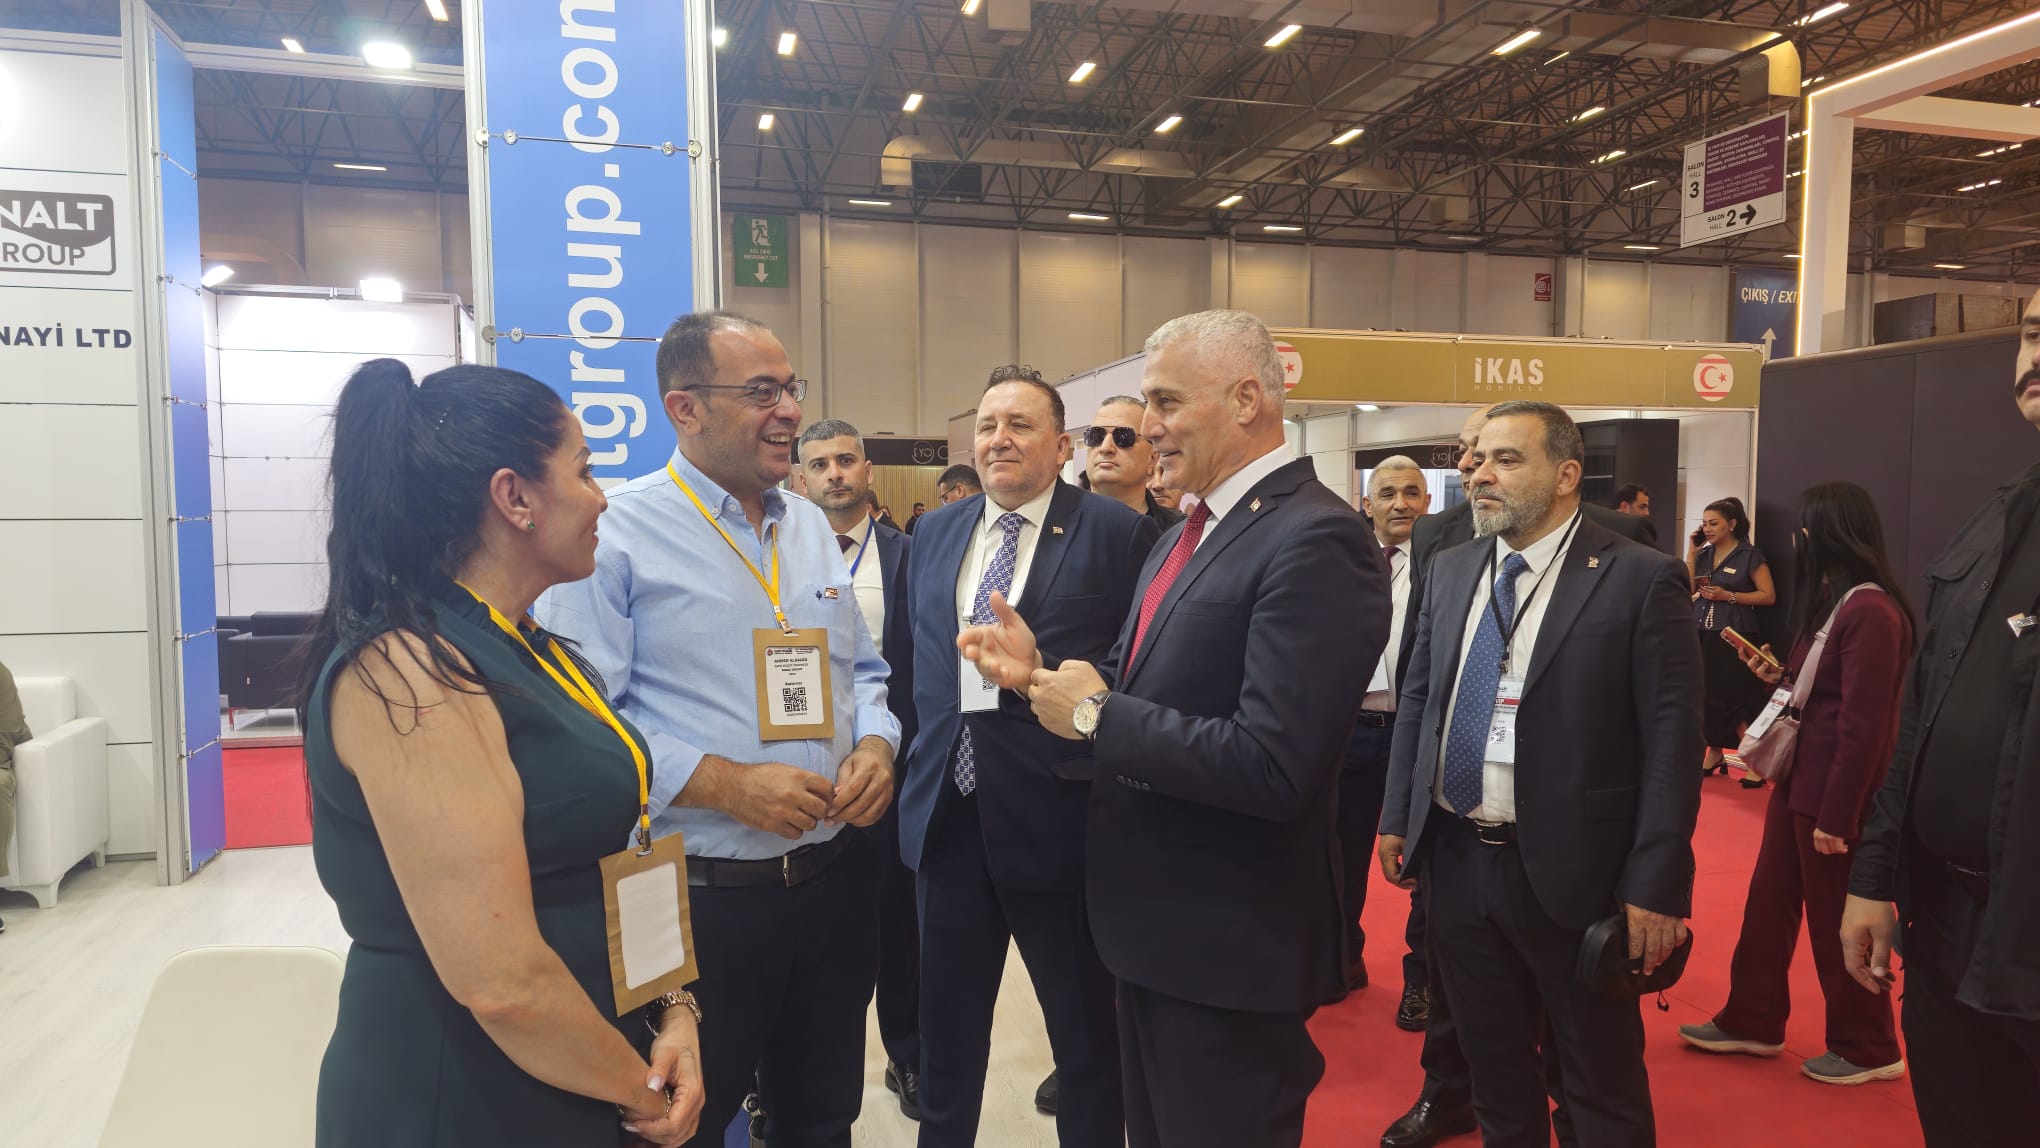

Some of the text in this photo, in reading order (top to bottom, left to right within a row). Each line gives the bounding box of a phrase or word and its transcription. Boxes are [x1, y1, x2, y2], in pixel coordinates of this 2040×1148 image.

[1687, 161, 1705, 171] SALON
[1689, 181, 1699, 199] 3
[1707, 209, 1737, 228] SALON 2
[2, 242, 86, 266] ROUP
[1741, 287, 1769, 305] ÇIKIŞ
[76, 328, 132, 348] LTD
